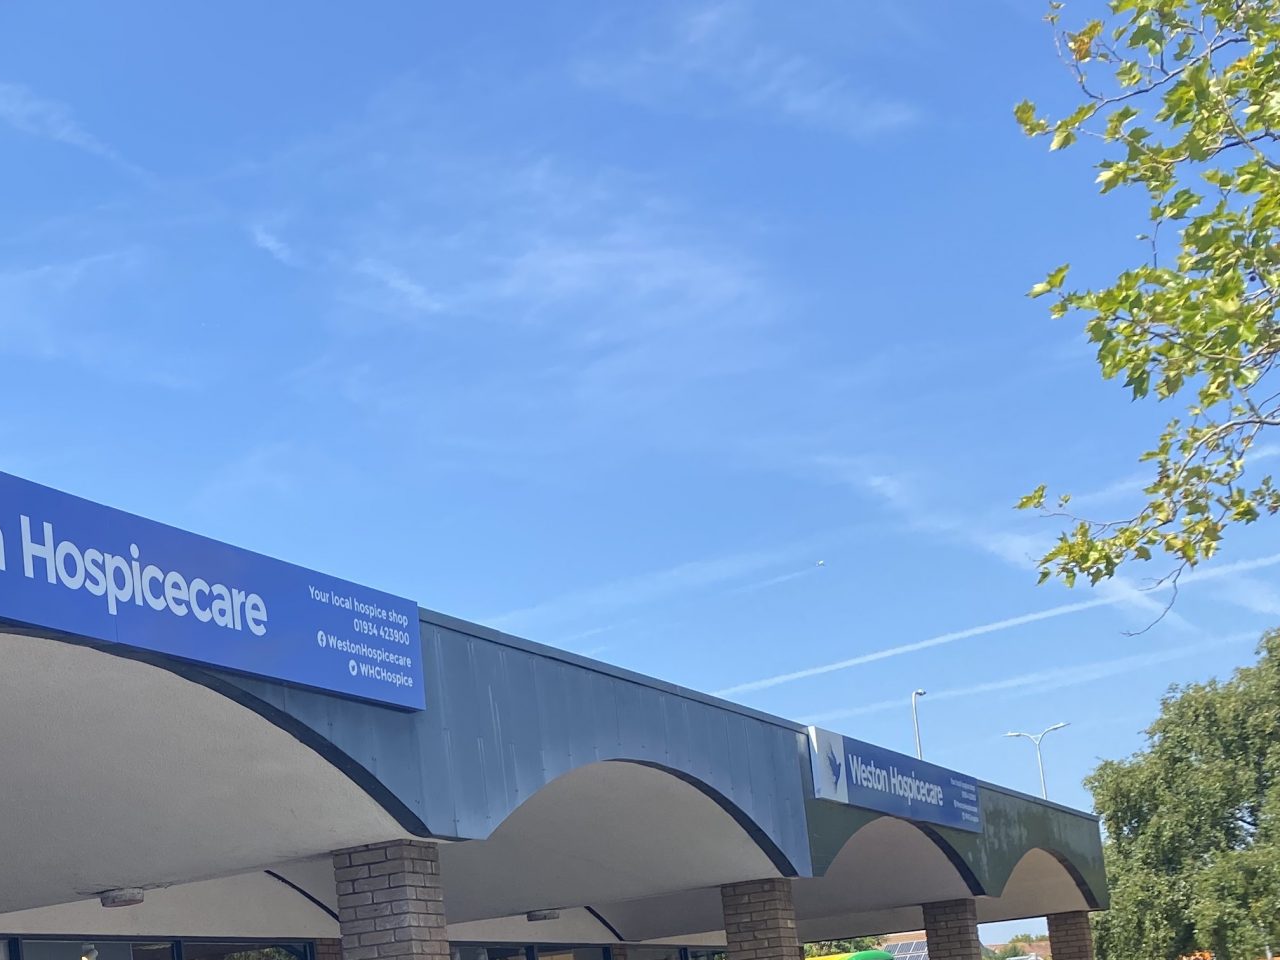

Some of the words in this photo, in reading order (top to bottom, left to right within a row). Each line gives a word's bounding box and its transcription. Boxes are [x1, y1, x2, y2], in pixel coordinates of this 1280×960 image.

[20, 514, 268, 637] Hospicecare
[308, 585, 329, 604] Your
[331, 591, 353, 610] local
[354, 598, 387, 620] hospice
[388, 609, 409, 628] shop
[327, 634, 412, 668] WestonHospicecare
[353, 618, 378, 637] 01934
[379, 627, 410, 646] 423900
[359, 662, 414, 687] WHCHospice
[848, 754, 888, 793] Weston
[889, 765, 944, 806] Hospicecare
